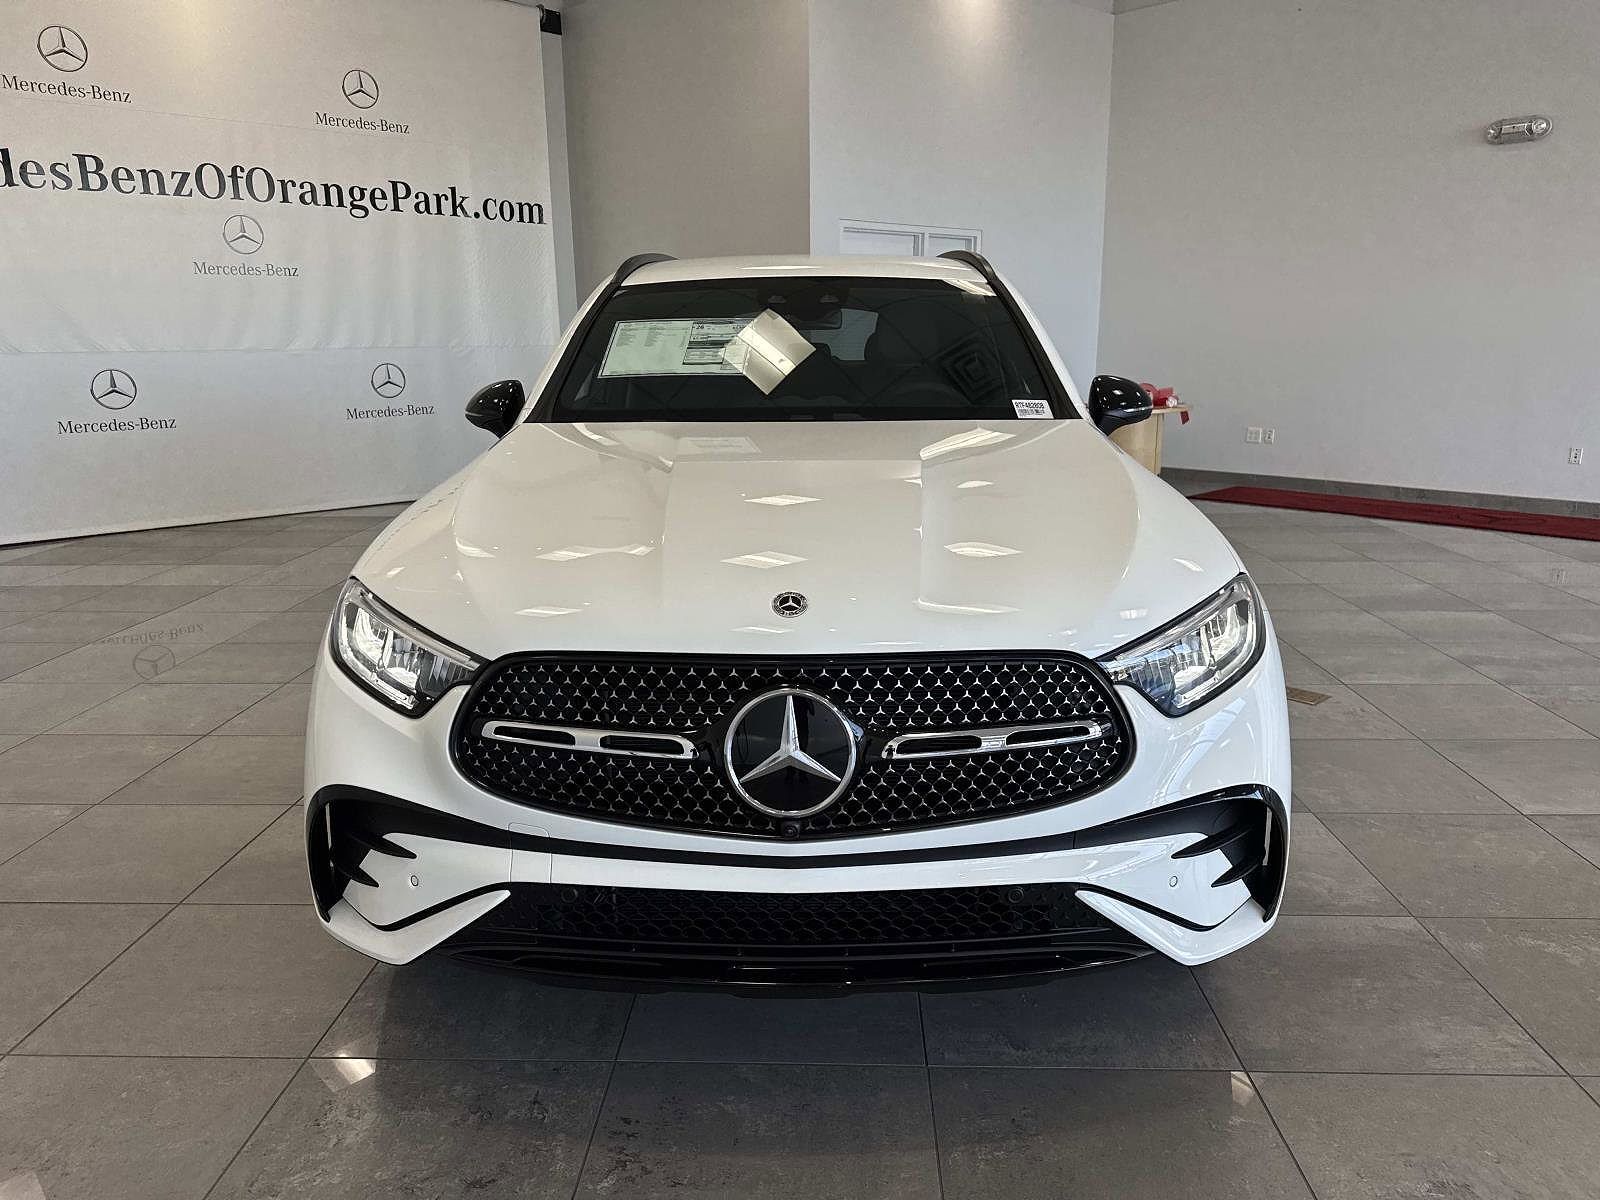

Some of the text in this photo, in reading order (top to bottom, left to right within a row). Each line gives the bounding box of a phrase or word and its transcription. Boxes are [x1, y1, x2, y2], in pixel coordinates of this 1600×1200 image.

[1, 74, 132, 104] Mercedes-Benz
[314, 111, 410, 135] Mercedes-Benz
[192, 261, 299, 278] Mercedes-Benz
[347, 404, 435, 420] Mercedes-Benz
[57, 417, 177, 435] Mercedes-Benz
